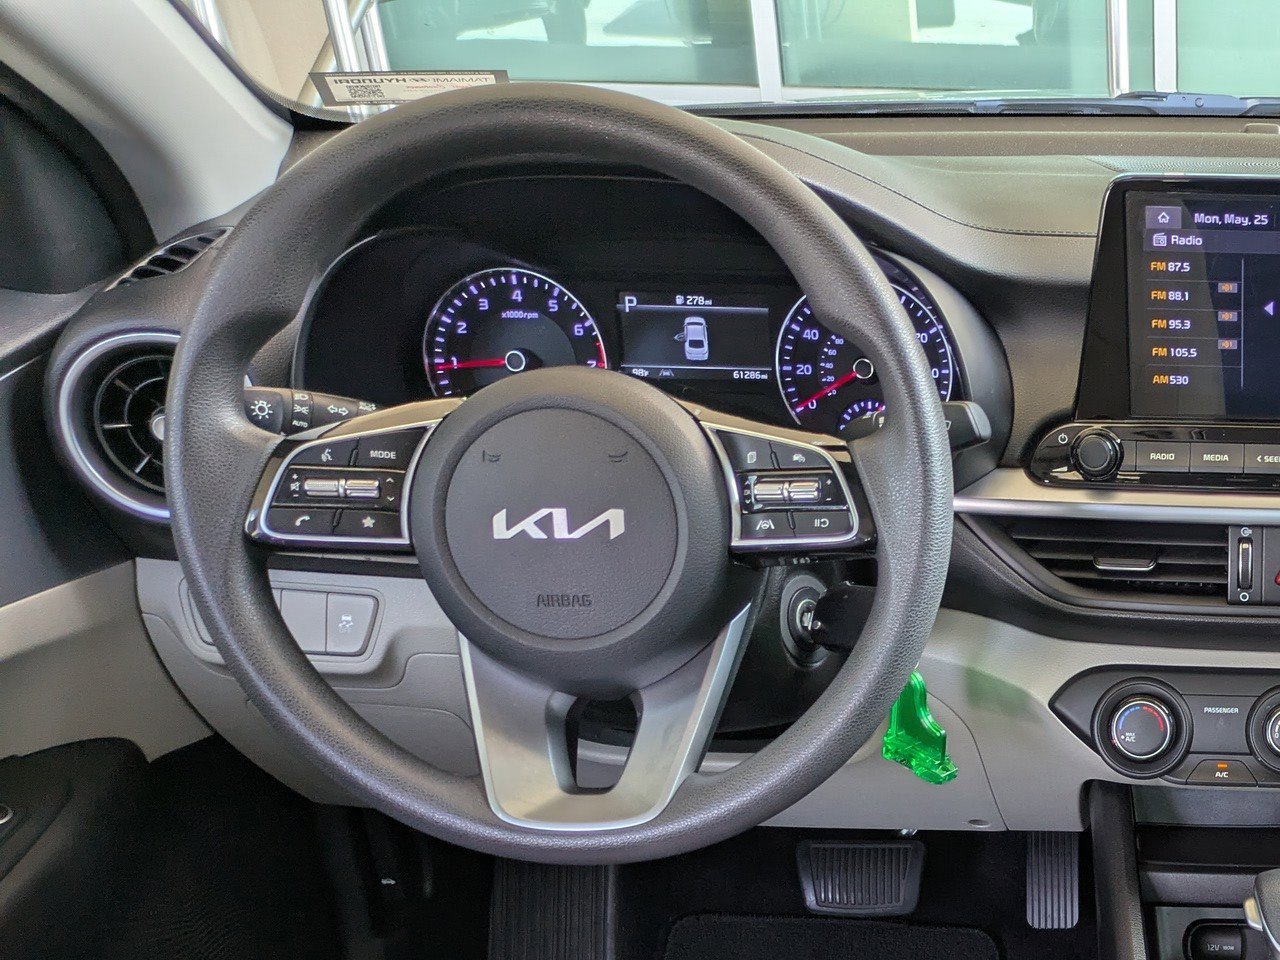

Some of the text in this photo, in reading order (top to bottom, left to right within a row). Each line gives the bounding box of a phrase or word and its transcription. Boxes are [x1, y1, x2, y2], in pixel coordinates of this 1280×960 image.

[1194, 213, 1222, 226] Mon,
[1253, 214, 1269, 225] 25
[1171, 233, 1203, 247] Radio
[1150, 261, 1191, 273] FM 87.5
[511, 289, 523, 302] 4
[1150, 290, 1189, 301] FM 88.1
[478, 298, 489, 311] 3
[548, 300, 559, 313] 5
[624, 295, 638, 313] P
[501, 310, 539, 320] x1000rpm
[456, 322, 467, 334] 2
[573, 324, 584, 336] 6
[1151, 319, 1191, 330] FM 95.3
[802, 328, 819, 341] 40
[1152, 347, 1197, 358] FM 105.5
[796, 364, 812, 376] 20
[1152, 375, 1189, 385] AM 530
[291, 419, 308, 429] AUTO
[369, 449, 397, 460] MODE
[1150, 452, 1175, 461] RADIO
[1203, 453, 1229, 462] MEDIA
[491, 507, 625, 541] KIA
[535, 593, 593, 608] AIRBAG
